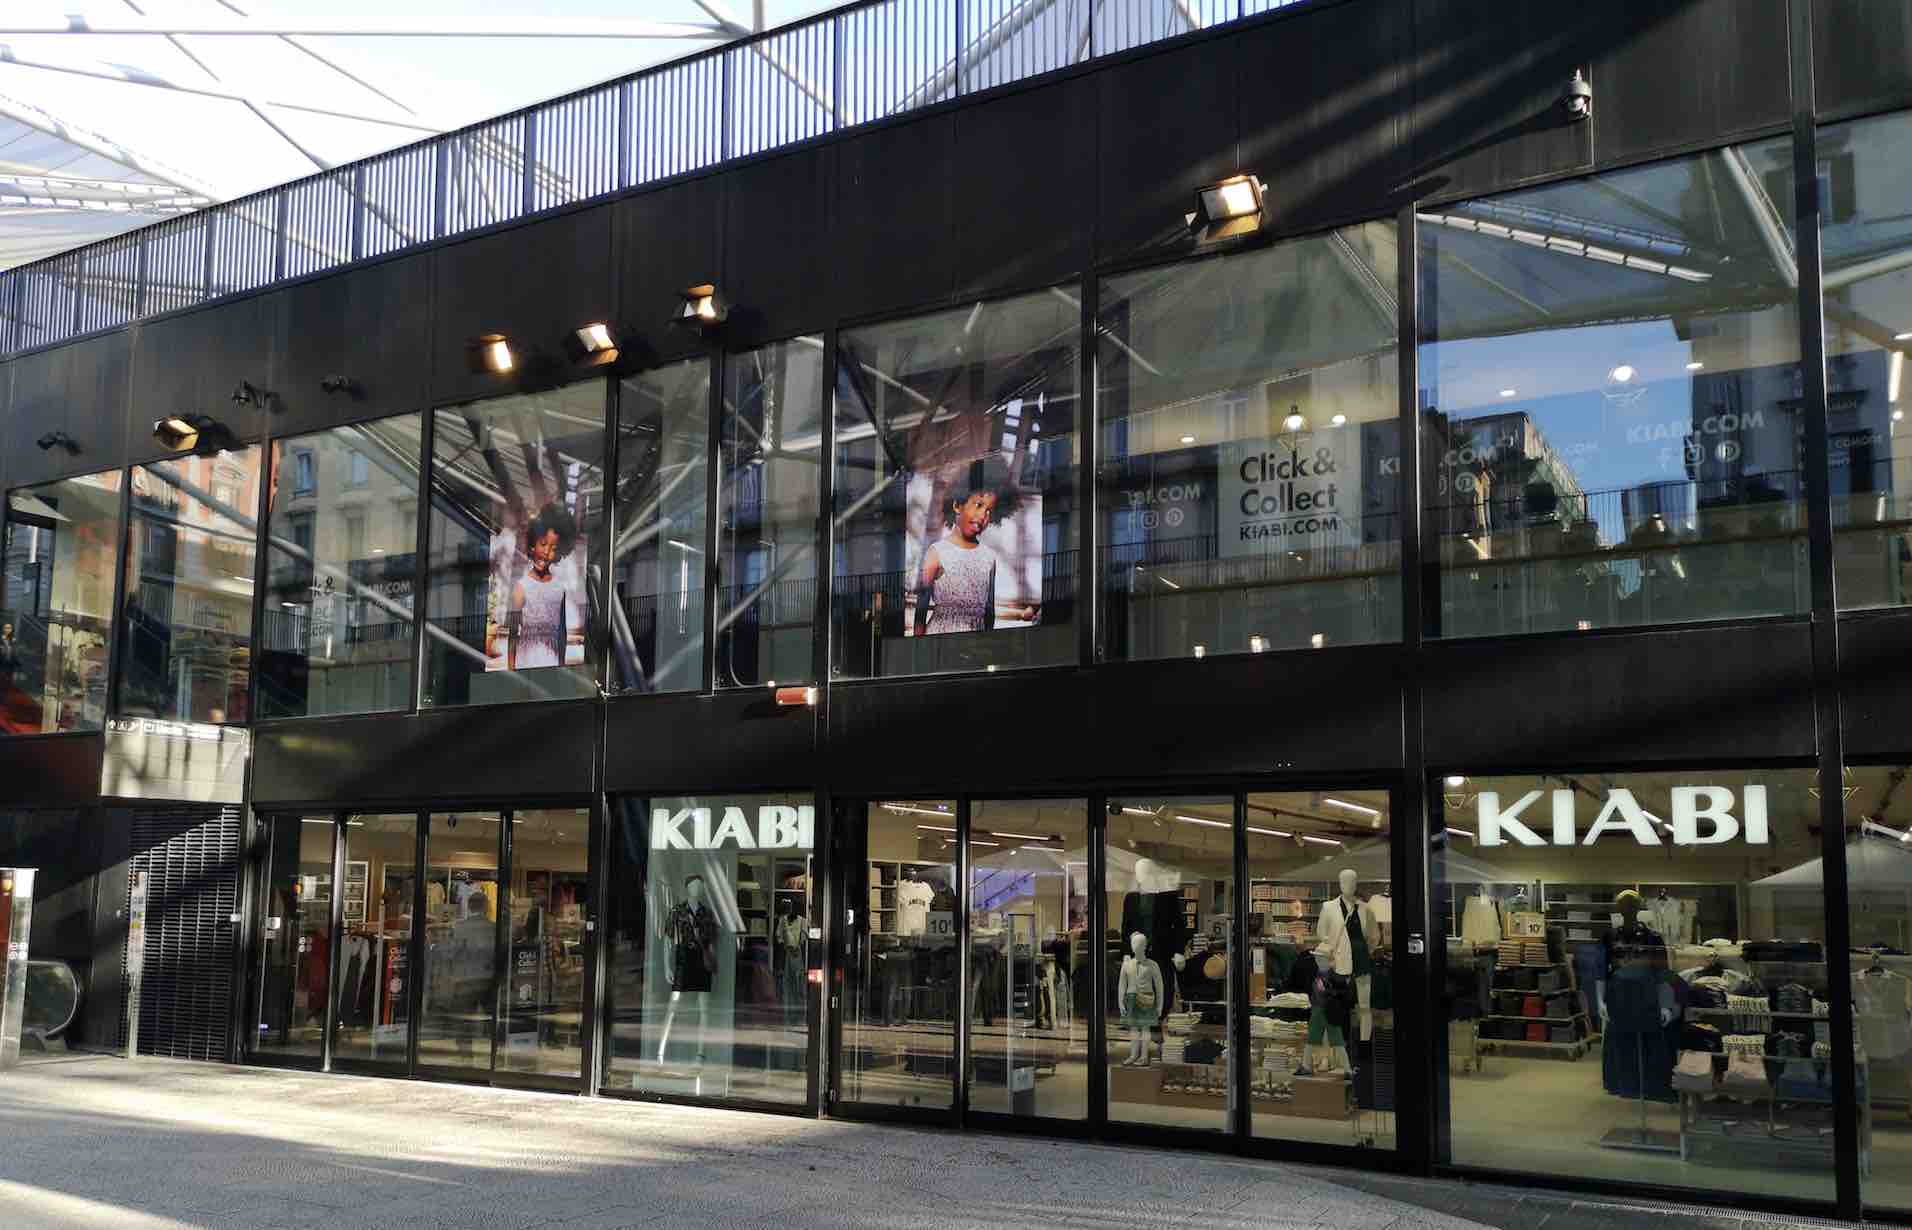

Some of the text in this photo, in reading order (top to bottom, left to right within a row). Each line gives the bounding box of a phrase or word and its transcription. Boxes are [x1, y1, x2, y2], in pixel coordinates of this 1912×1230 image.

[1239, 482, 1337, 516] Collect
[1239, 517, 1338, 541] KIABI.COM
[651, 805, 815, 850] KIABI
[1478, 785, 1768, 846] KIABI
